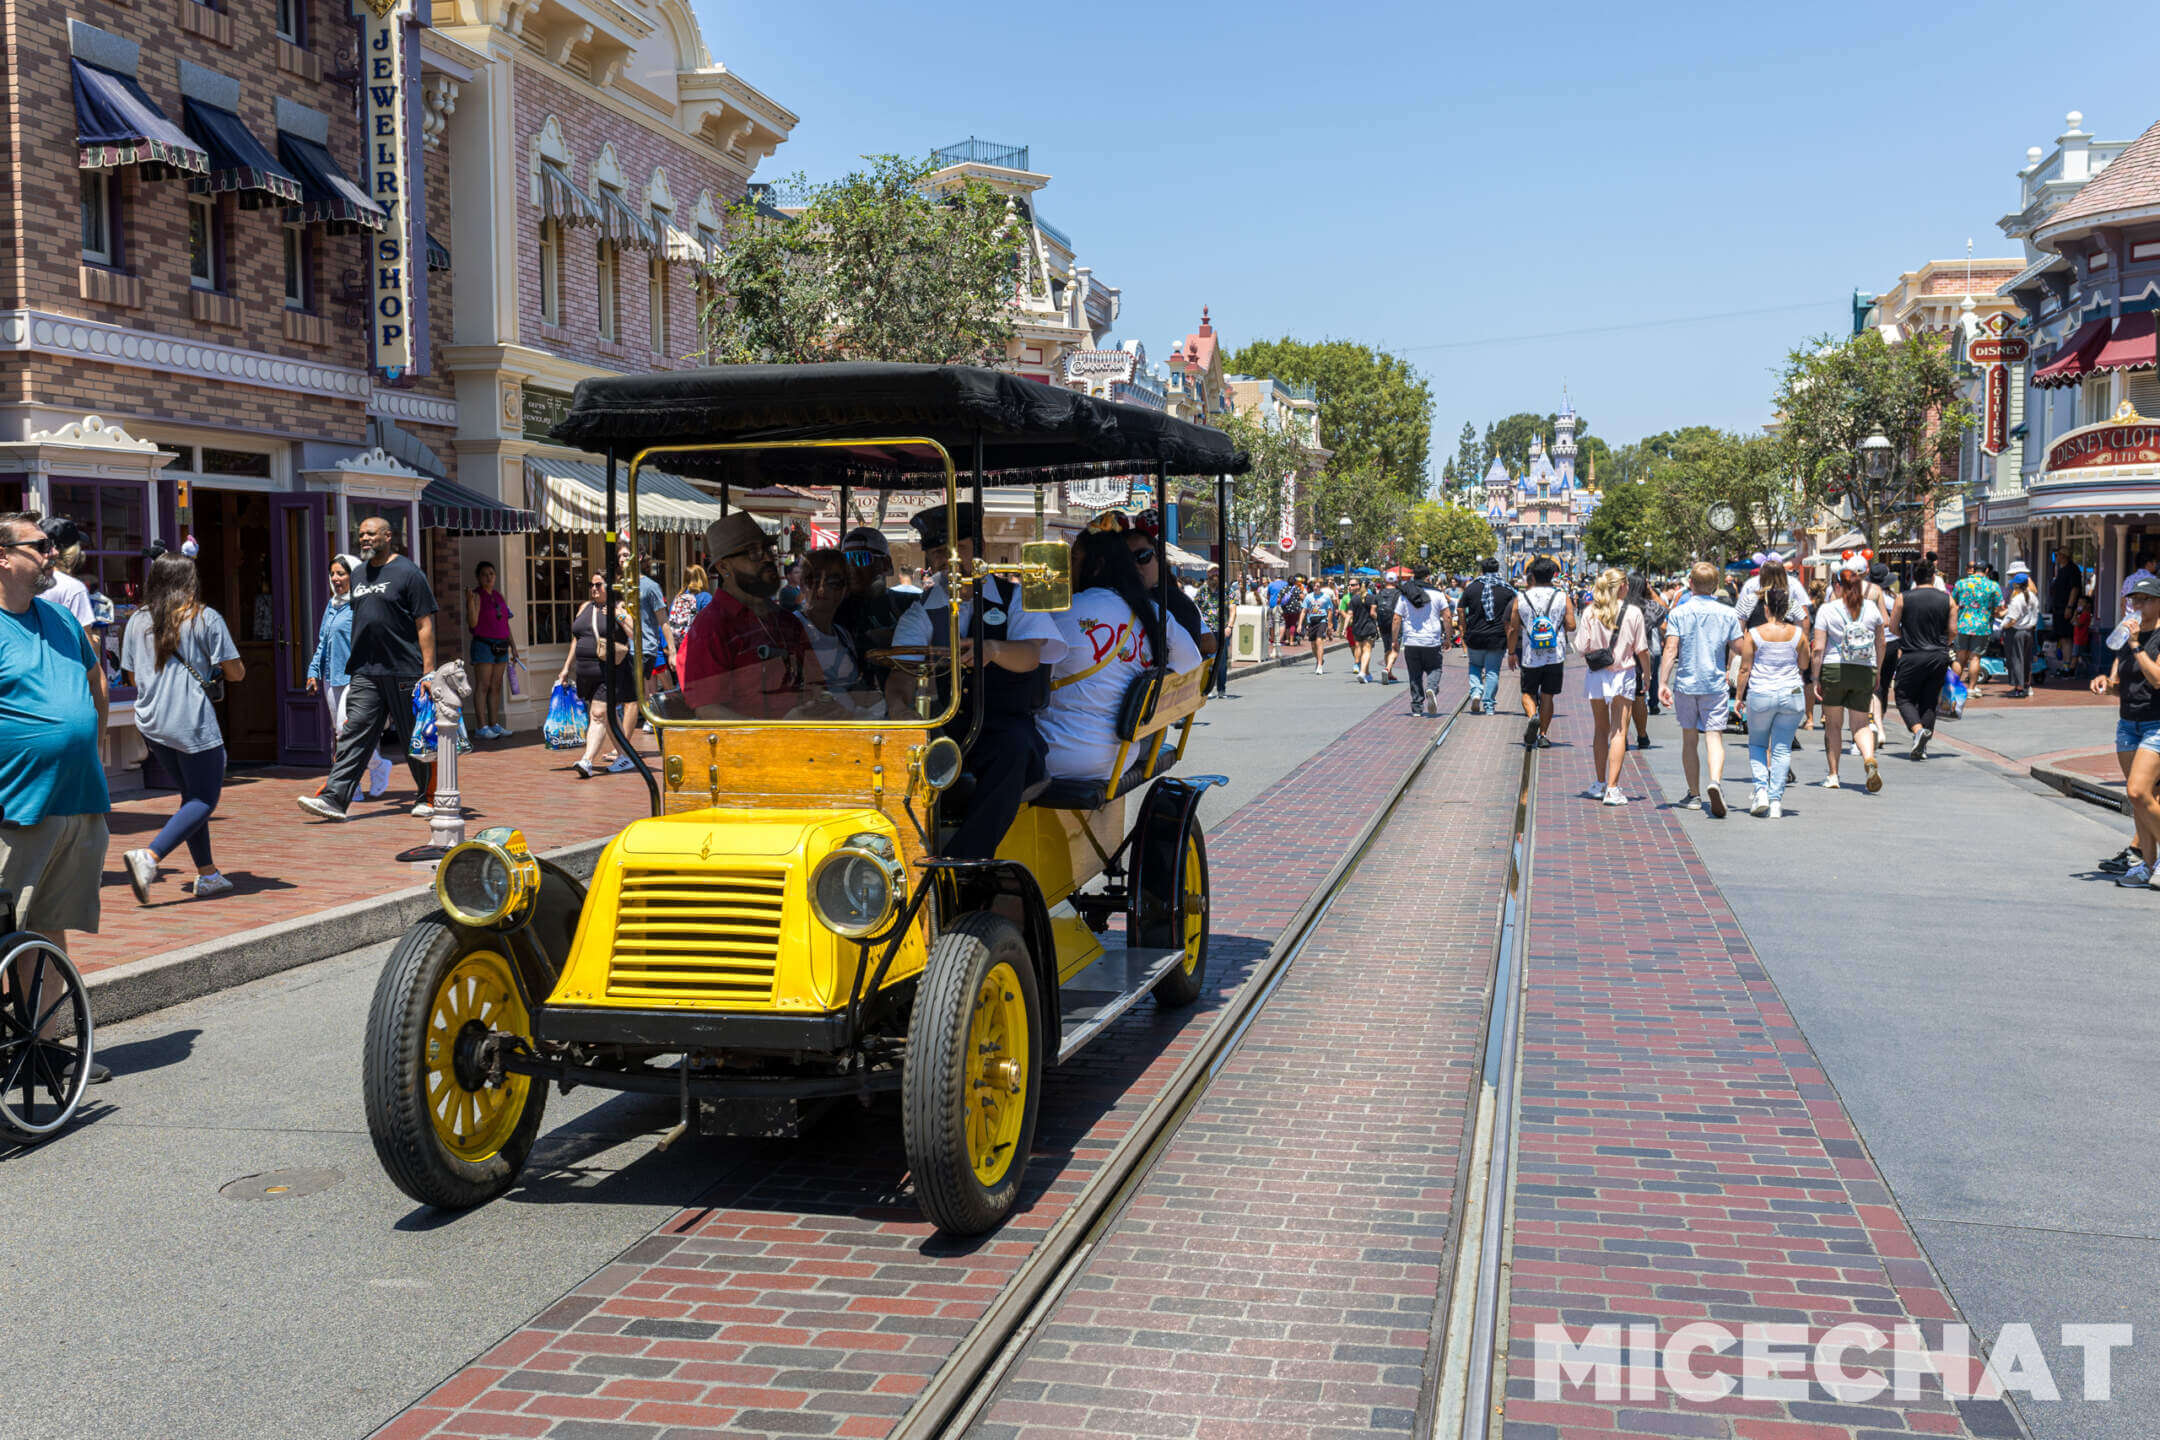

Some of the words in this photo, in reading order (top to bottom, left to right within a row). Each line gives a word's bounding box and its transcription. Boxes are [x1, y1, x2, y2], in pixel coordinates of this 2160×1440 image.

[370, 29, 399, 221] JEWELRY
[379, 239, 403, 345] SHOP
[1975, 345, 2022, 356] DISNEY
[1993, 370, 2003, 444] CLOTHIERS
[2057, 431, 2109, 465] DISNEY
[2111, 427, 2160, 448] CLOT
